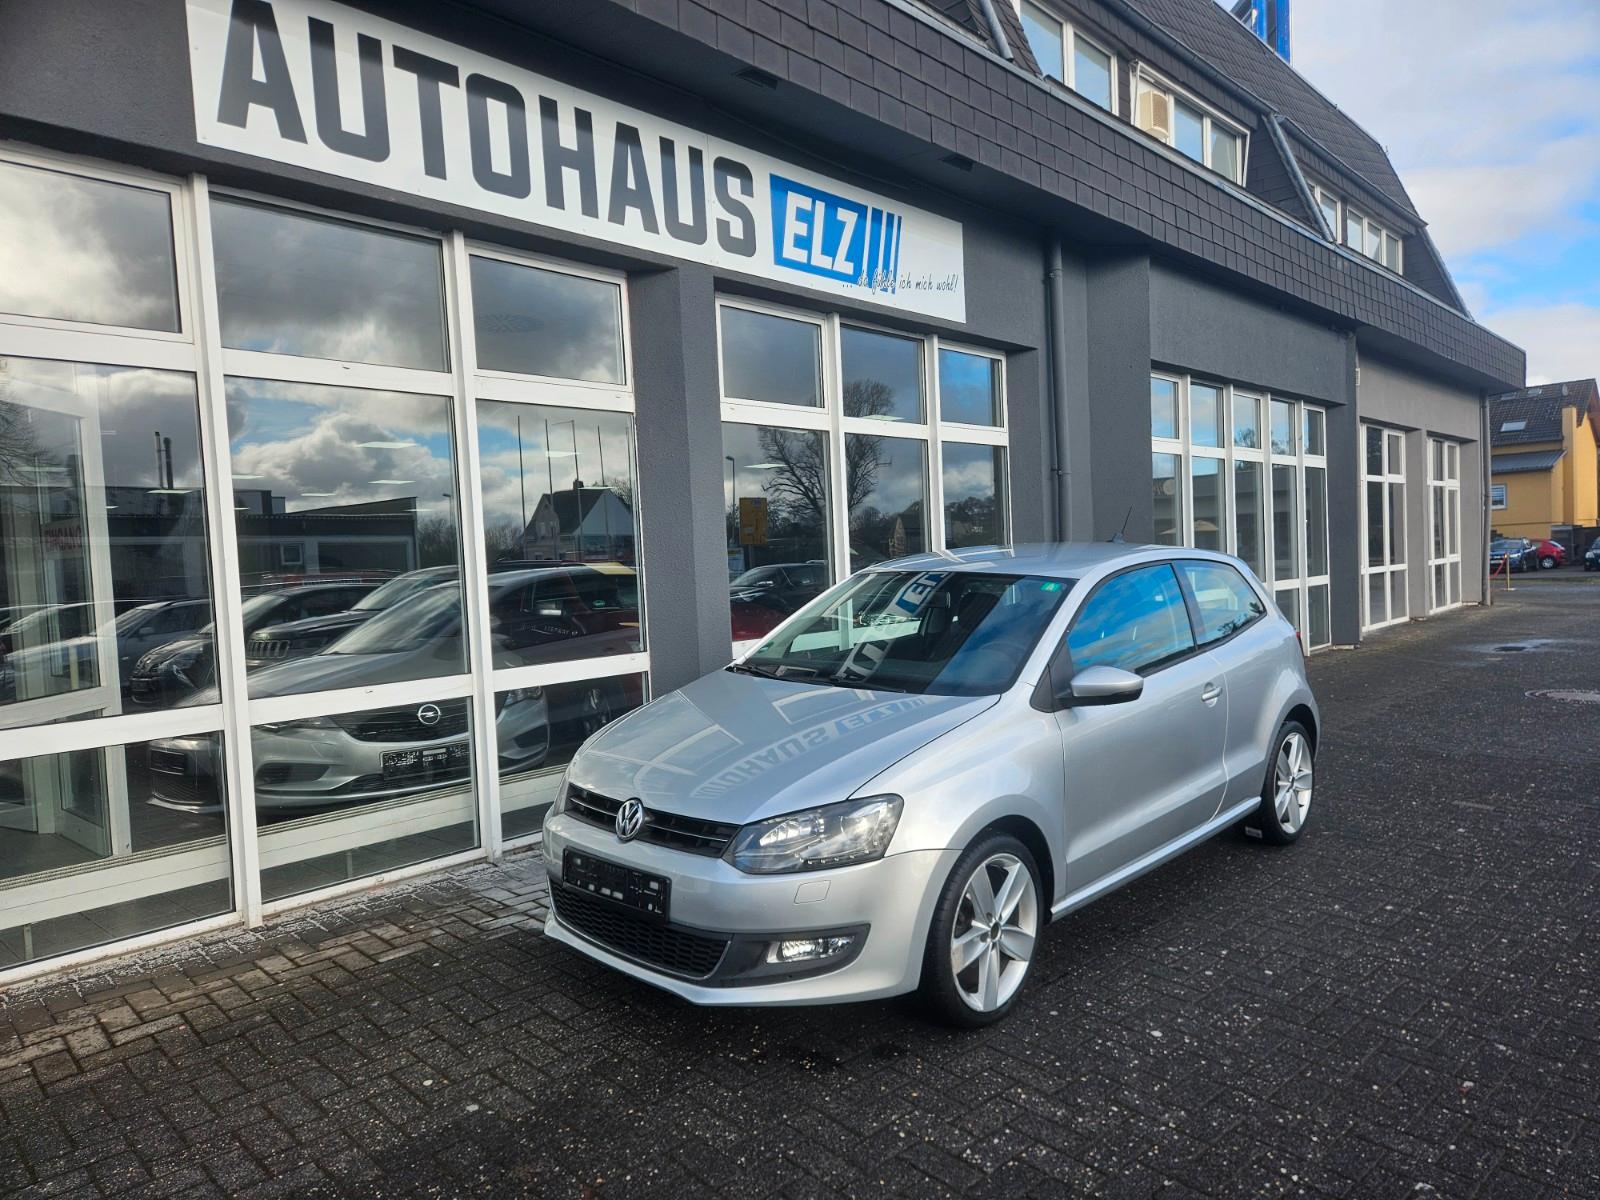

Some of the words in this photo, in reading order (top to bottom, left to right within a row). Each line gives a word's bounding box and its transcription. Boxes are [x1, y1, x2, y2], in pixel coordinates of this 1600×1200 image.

[217, 0, 756, 258] AUTOHAUS
[782, 191, 859, 276] ELZ
[899, 271, 912, 289] ich
[915, 271, 934, 291] mich
[936, 273, 960, 293] wohl!
